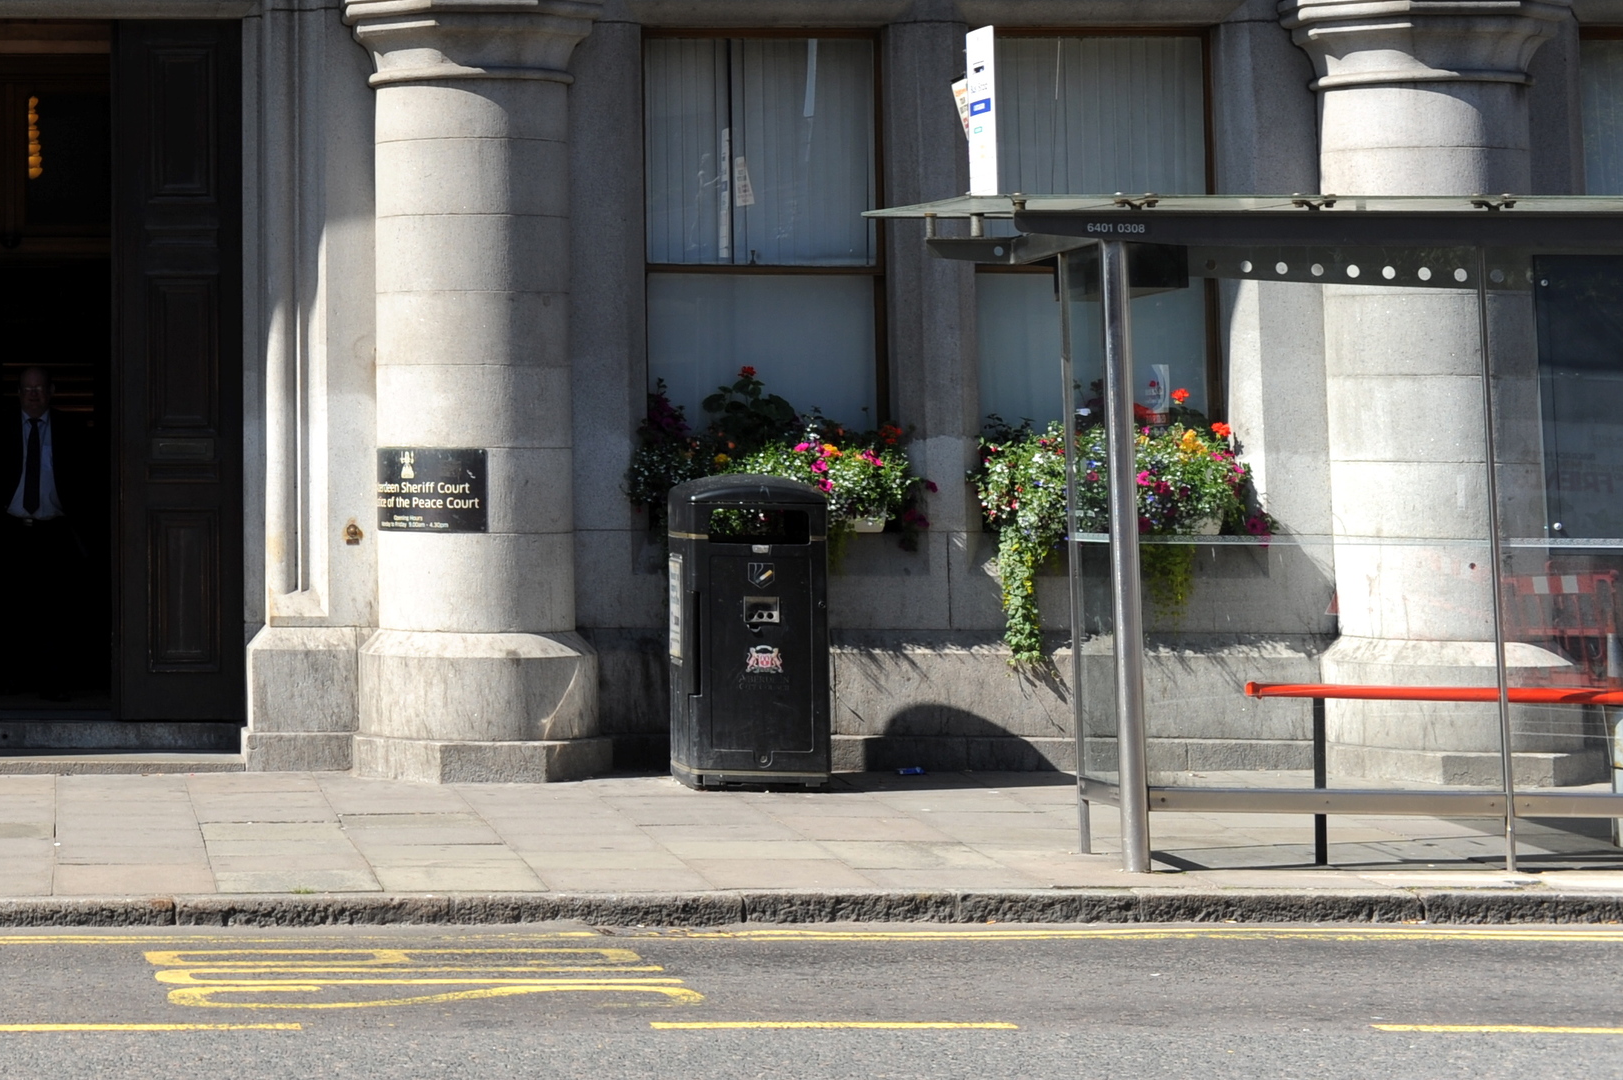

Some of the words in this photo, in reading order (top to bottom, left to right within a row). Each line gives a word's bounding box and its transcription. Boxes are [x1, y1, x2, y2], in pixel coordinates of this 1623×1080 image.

[1087, 223, 1113, 232] 6401
[1117, 224, 1145, 233] 0308
[401, 481, 435, 493] Sheriff
[437, 482, 470, 494] Court
[387, 496, 394, 508] of
[396, 497, 410, 508] the
[412, 497, 443, 508] Peace
[446, 497, 479, 509] Court
[144, 947, 704, 1009] BUS
